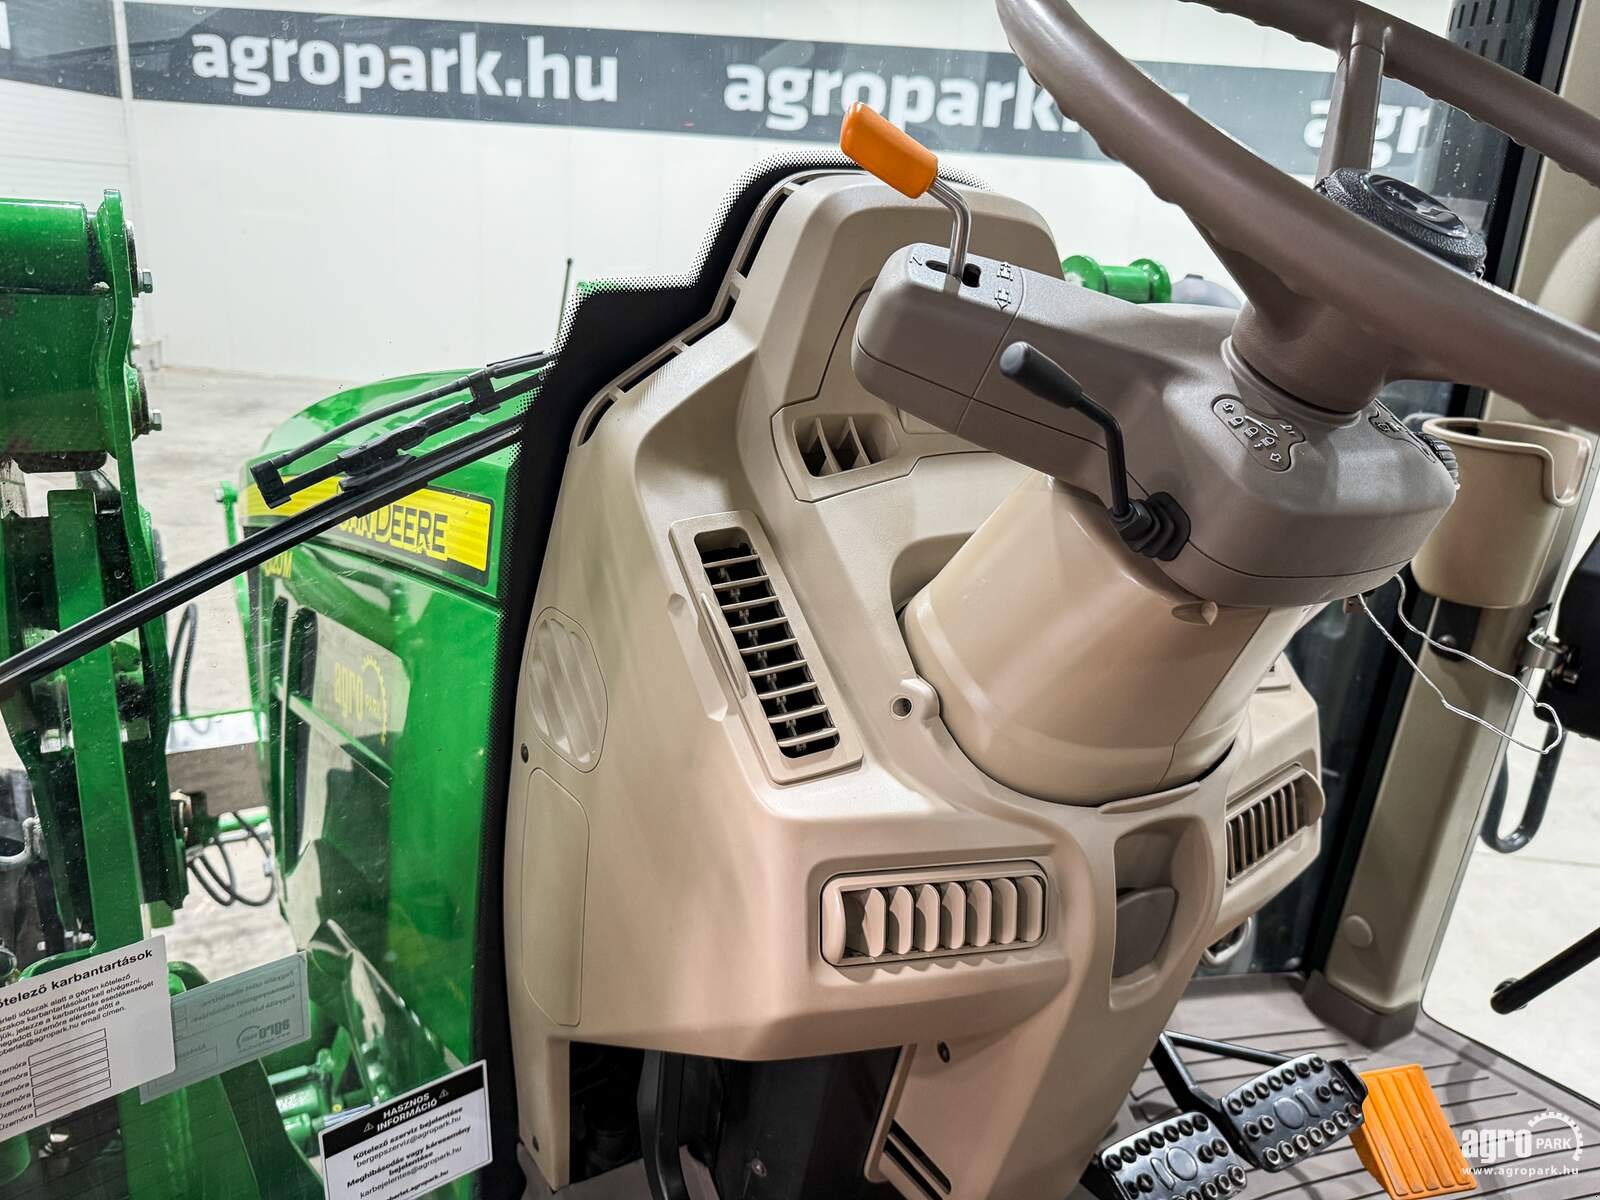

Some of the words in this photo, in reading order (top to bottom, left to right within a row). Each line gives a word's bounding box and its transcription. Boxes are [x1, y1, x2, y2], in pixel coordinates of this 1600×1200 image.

[191, 32, 618, 104] agropark.hu
[375, 503, 448, 560] DEERE
[51, 949, 153, 990] karbantartások
[376, 1097, 438, 1132] INFORMÁCIÓ
[383, 1092, 430, 1119] HASZNOS
